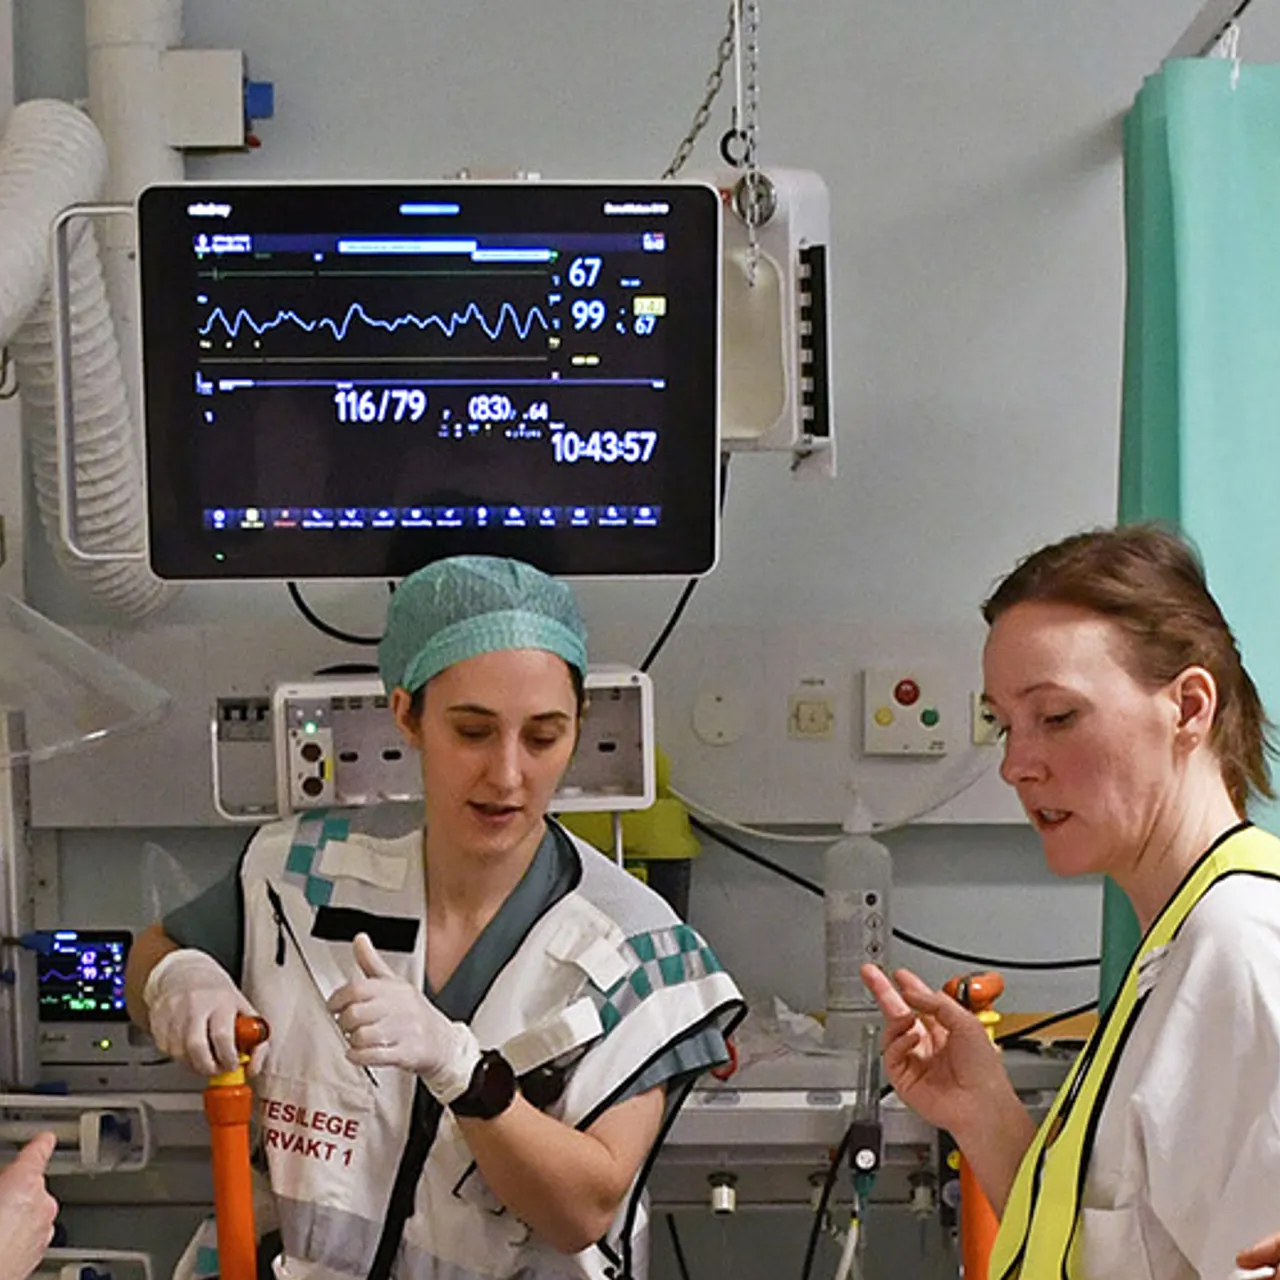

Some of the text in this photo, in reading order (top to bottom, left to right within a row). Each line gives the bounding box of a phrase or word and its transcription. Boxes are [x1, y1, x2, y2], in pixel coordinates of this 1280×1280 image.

[569, 257, 602, 287] 67
[571, 300, 606, 331] 99
[634, 316, 656, 335] 67
[334, 389, 427, 422] 116/79
[551, 431, 658, 462] 10:43:57
[343, 1148, 354, 1167] 1
